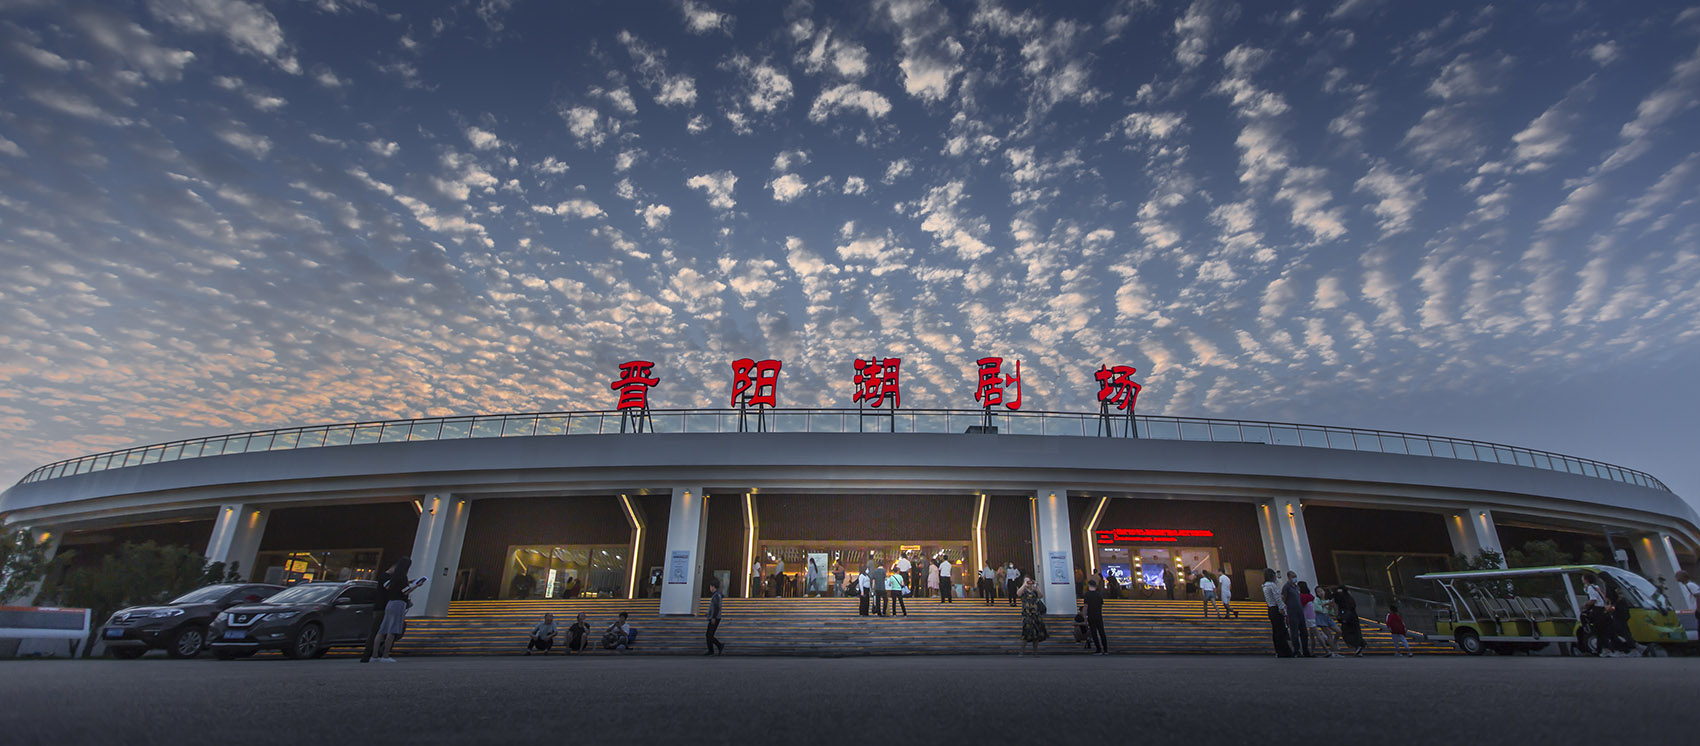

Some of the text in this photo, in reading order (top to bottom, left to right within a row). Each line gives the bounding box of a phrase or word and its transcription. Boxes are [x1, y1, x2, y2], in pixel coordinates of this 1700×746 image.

[611, 357, 1141, 411] 晋阳湖剧场
